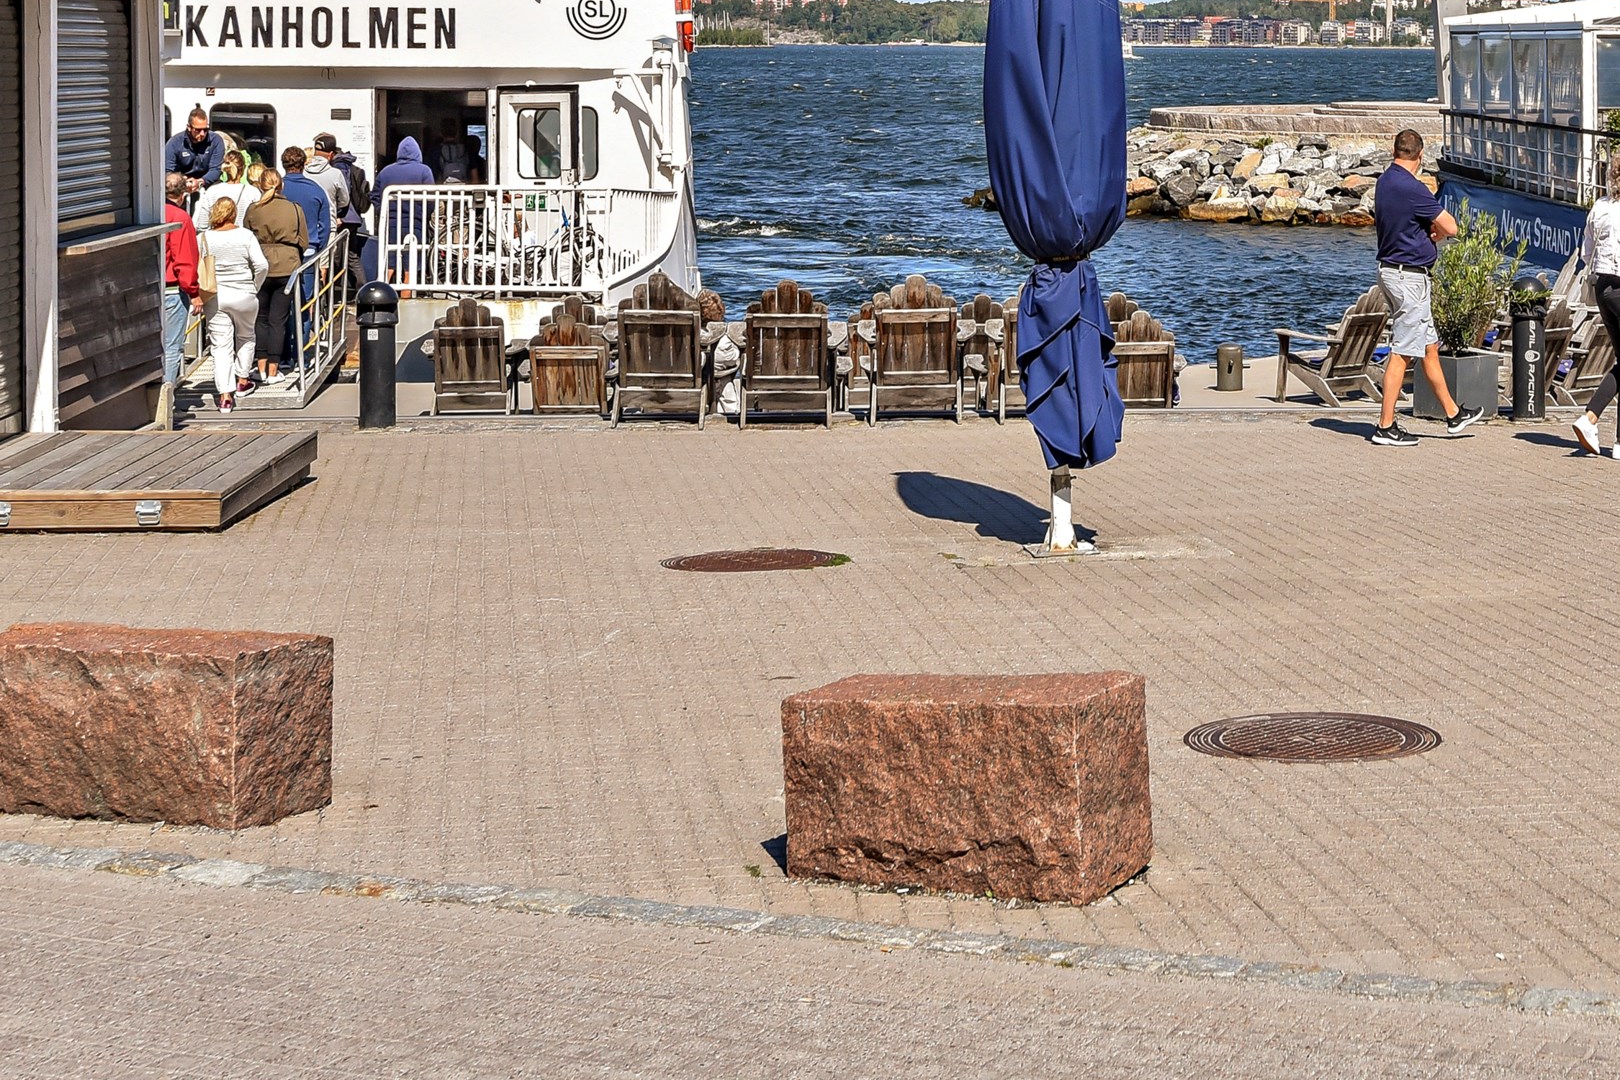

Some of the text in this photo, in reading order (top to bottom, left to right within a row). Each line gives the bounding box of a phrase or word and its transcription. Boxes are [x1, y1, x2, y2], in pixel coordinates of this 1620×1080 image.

[185, 5, 456, 49] KANHOLMEN
[584, 0, 610, 18] SL
[1533, 217, 1571, 256] STRAND
[1527, 363, 1536, 415] RACING
